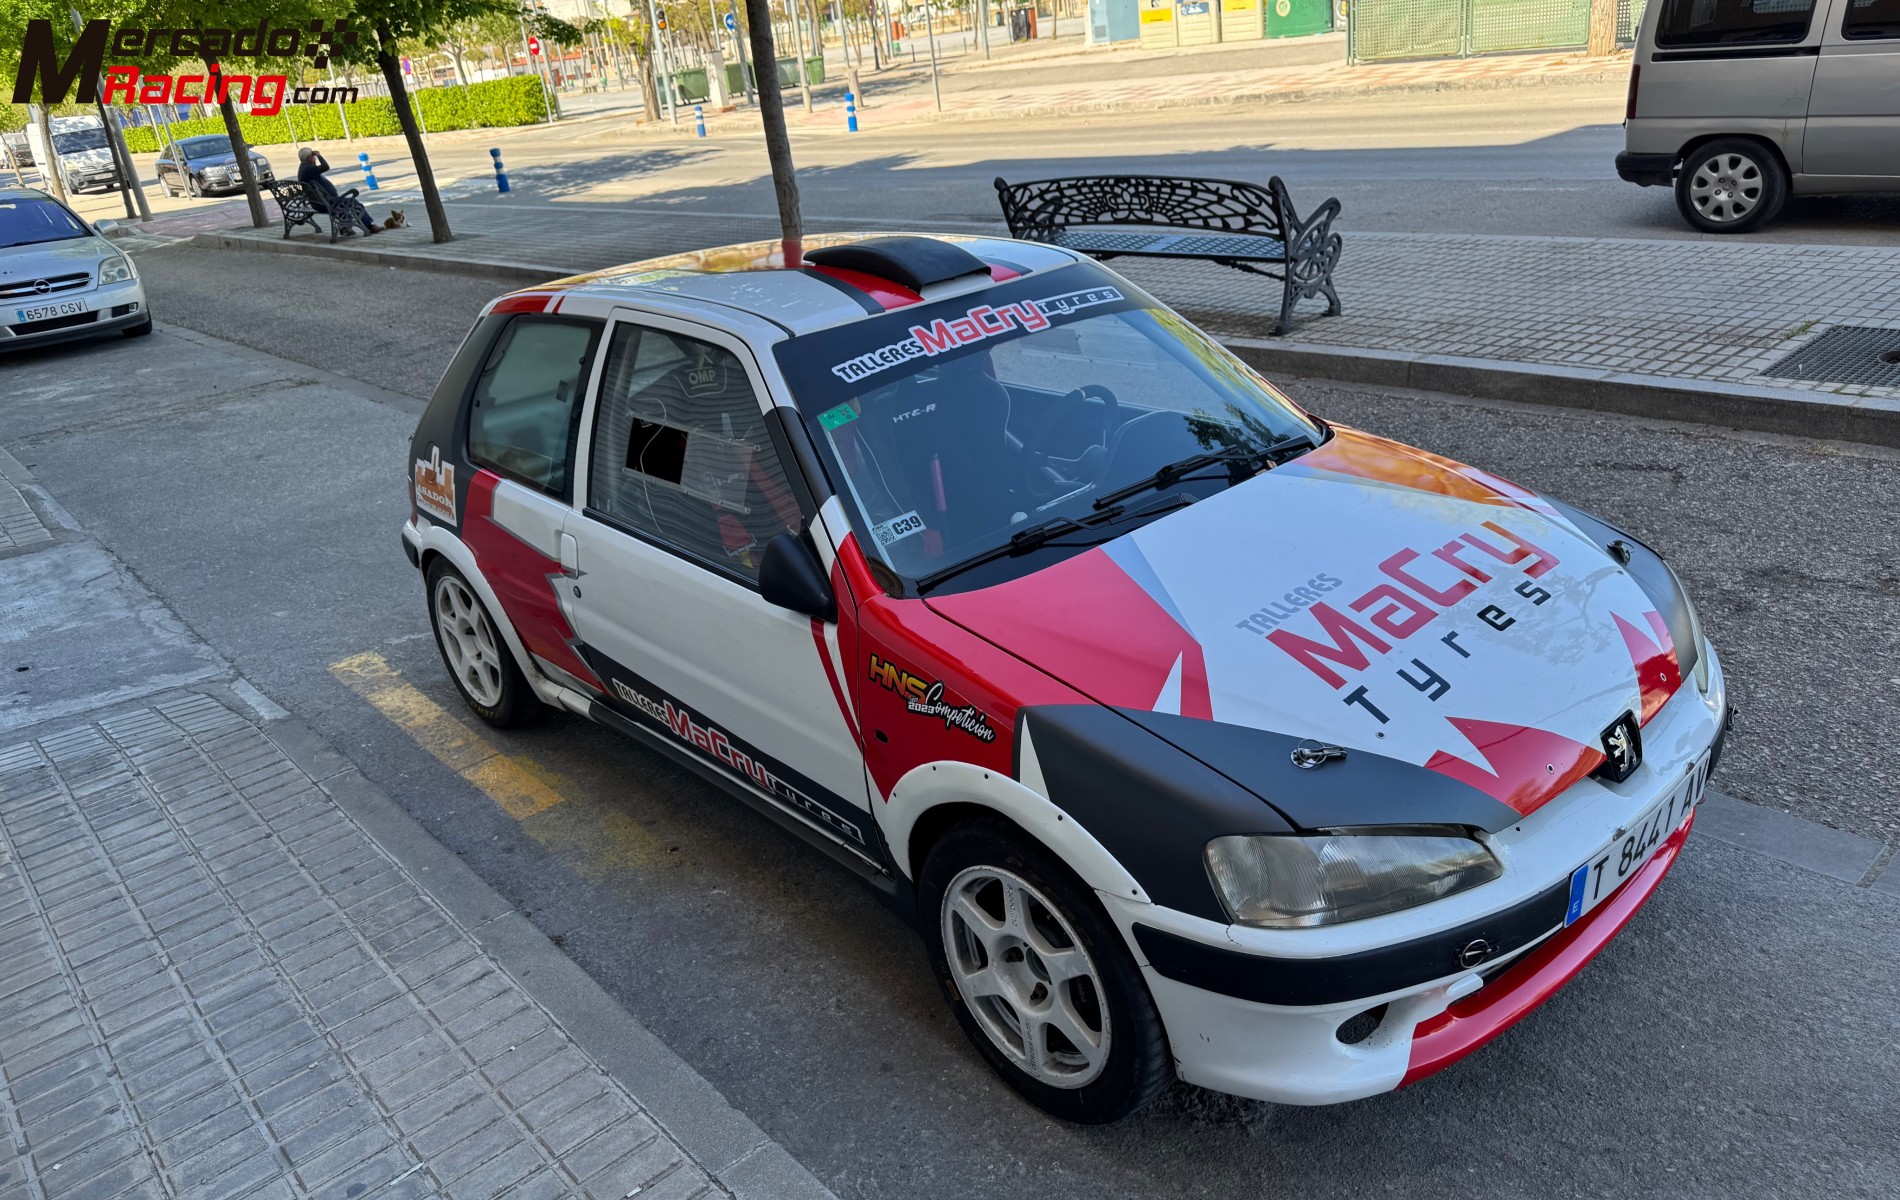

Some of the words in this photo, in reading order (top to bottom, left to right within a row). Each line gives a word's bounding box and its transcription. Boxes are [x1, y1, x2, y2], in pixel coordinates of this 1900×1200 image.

[26, 306, 58, 321] 6578
[60, 302, 83, 314] CSV
[836, 340, 924, 382] TALLERES
[911, 301, 1048, 354] MaCry
[688, 369, 716, 385] OMP
[416, 484, 454, 509] ASADOR
[892, 515, 922, 535] C39
[1235, 572, 1343, 636] TALLERES
[1265, 520, 1561, 691] MaCry
[1342, 580, 1552, 725] Tyres
[614, 680, 668, 724] TALLERES
[869, 654, 928, 707] HNS
[908, 701, 935, 714] 2023
[1594, 855, 1609, 900] T
[1617, 794, 1676, 877] 8441
[1572, 899, 1579, 914] E
